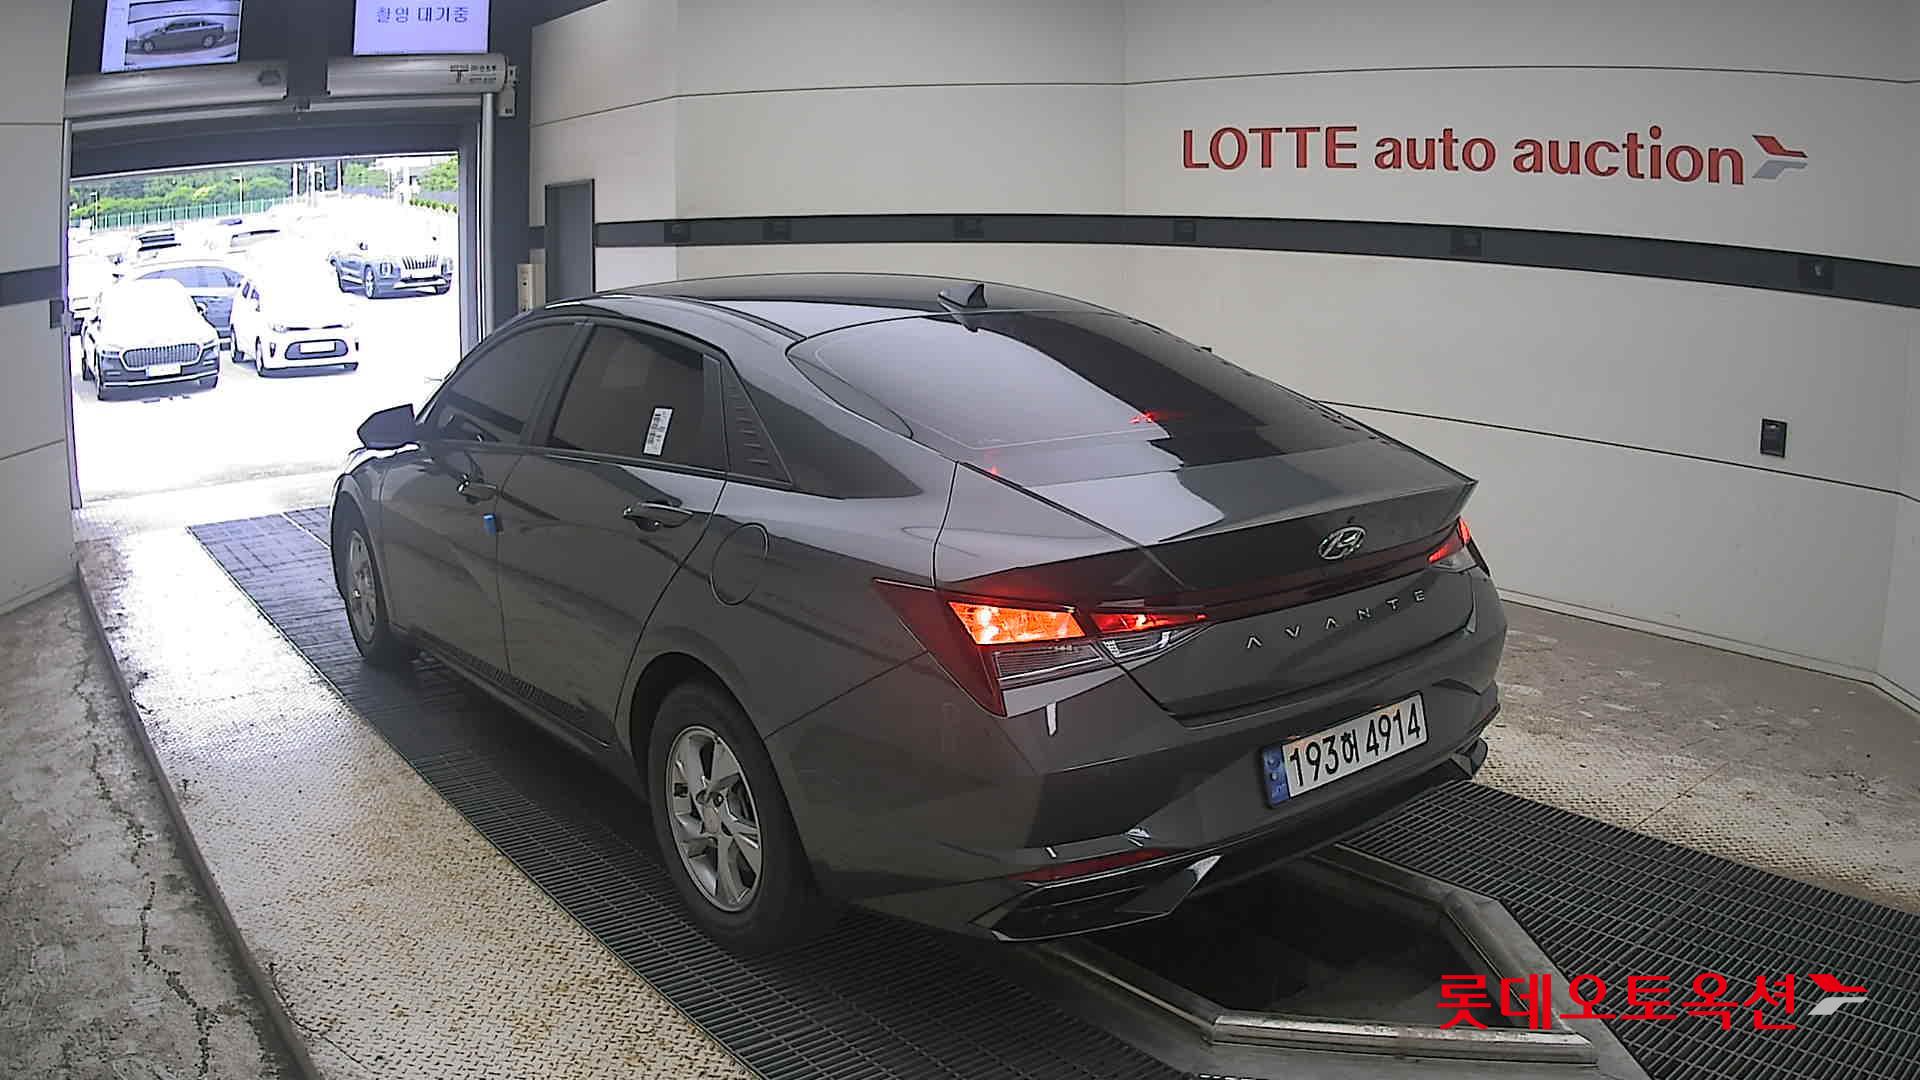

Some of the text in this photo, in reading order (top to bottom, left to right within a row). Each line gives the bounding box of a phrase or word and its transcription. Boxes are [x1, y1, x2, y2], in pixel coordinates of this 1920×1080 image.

[417, 6, 470, 23] 대기중
[1183, 125, 1744, 185] LOTTE auto auction
[1246, 588, 1426, 650] AVANTE
[1289, 701, 1422, 786] 193허 4914
